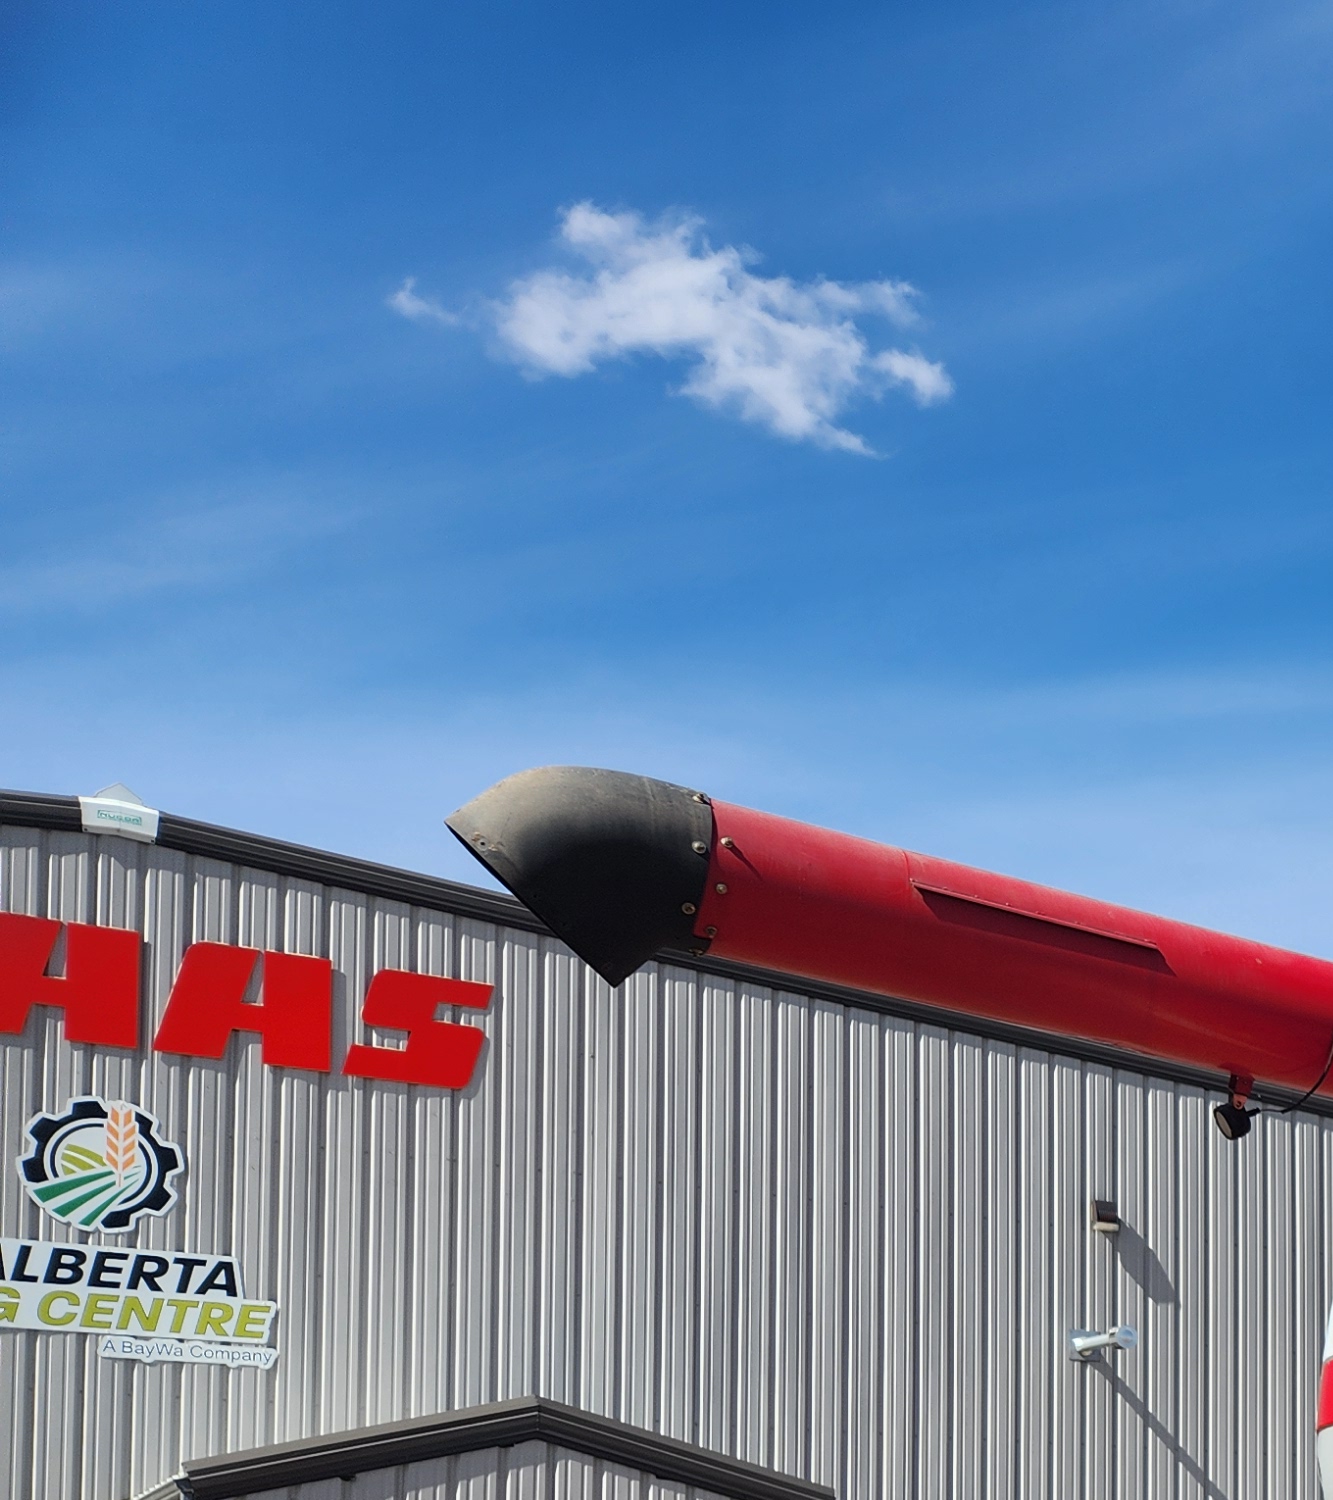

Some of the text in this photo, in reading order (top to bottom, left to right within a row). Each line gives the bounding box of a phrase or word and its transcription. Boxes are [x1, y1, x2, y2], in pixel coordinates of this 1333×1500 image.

[0, 1243, 239, 1298] LBERTA
[37, 1290, 272, 1339] CENTRE
[103, 1340, 273, 1365] A BayWa Company
